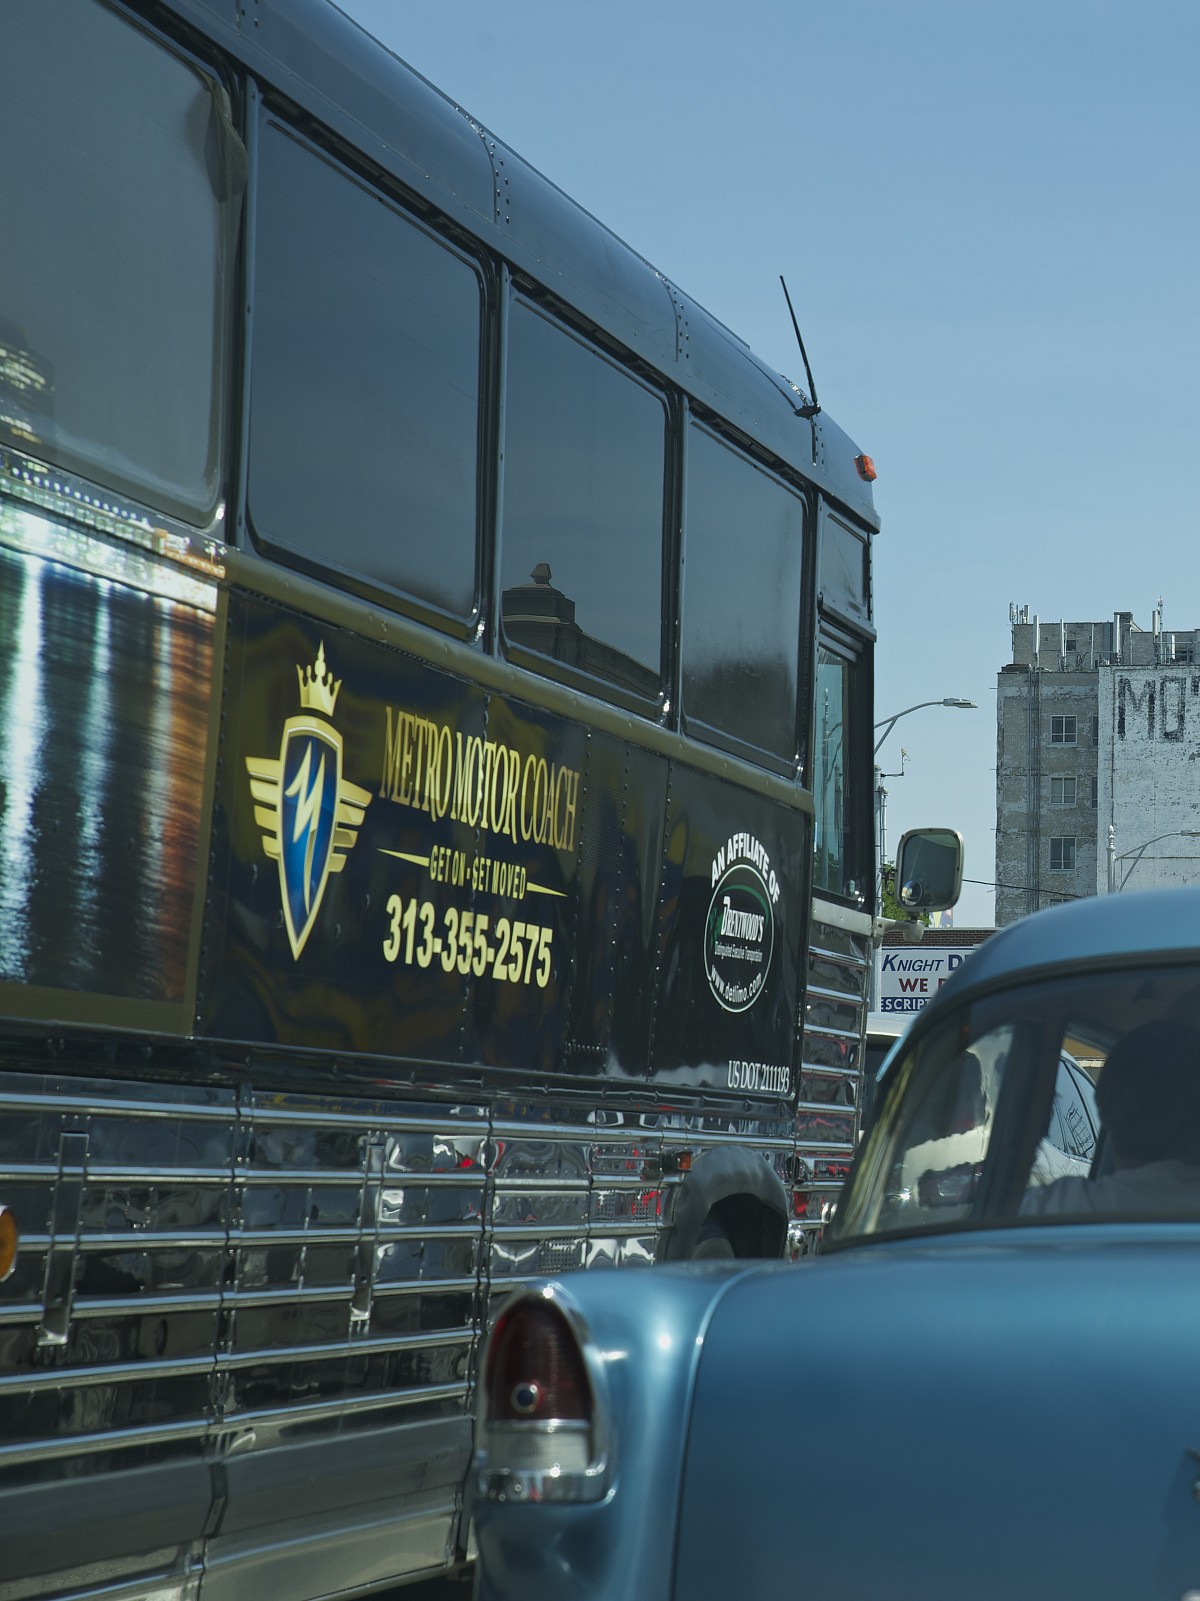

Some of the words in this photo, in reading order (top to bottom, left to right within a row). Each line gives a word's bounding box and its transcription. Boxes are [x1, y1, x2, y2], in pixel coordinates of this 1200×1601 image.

[379, 706, 452, 822] METRO
[450, 732, 521, 844] MOTOR
[521, 754, 580, 852] COACH
[430, 844, 451, 883] GET
[451, 850, 466, 887] ON
[471, 856, 491, 893] SET
[491, 861, 527, 900] MOVED
[712, 846, 725, 889] AN
[727, 833, 770, 881] AFFILIATE
[769, 870, 780, 904] OF
[383, 894, 553, 988] 313-355-2575
[720, 896, 765, 942] BRENTWOOD'S
[711, 964, 762, 1003] www.detlimo.com
[898, 978, 928, 993] WE
[948, 954, 972, 971] D
[728, 1060, 740, 1089] US
[740, 1061, 761, 1090] DOT
[760, 1064, 790, 1093] 2111193
